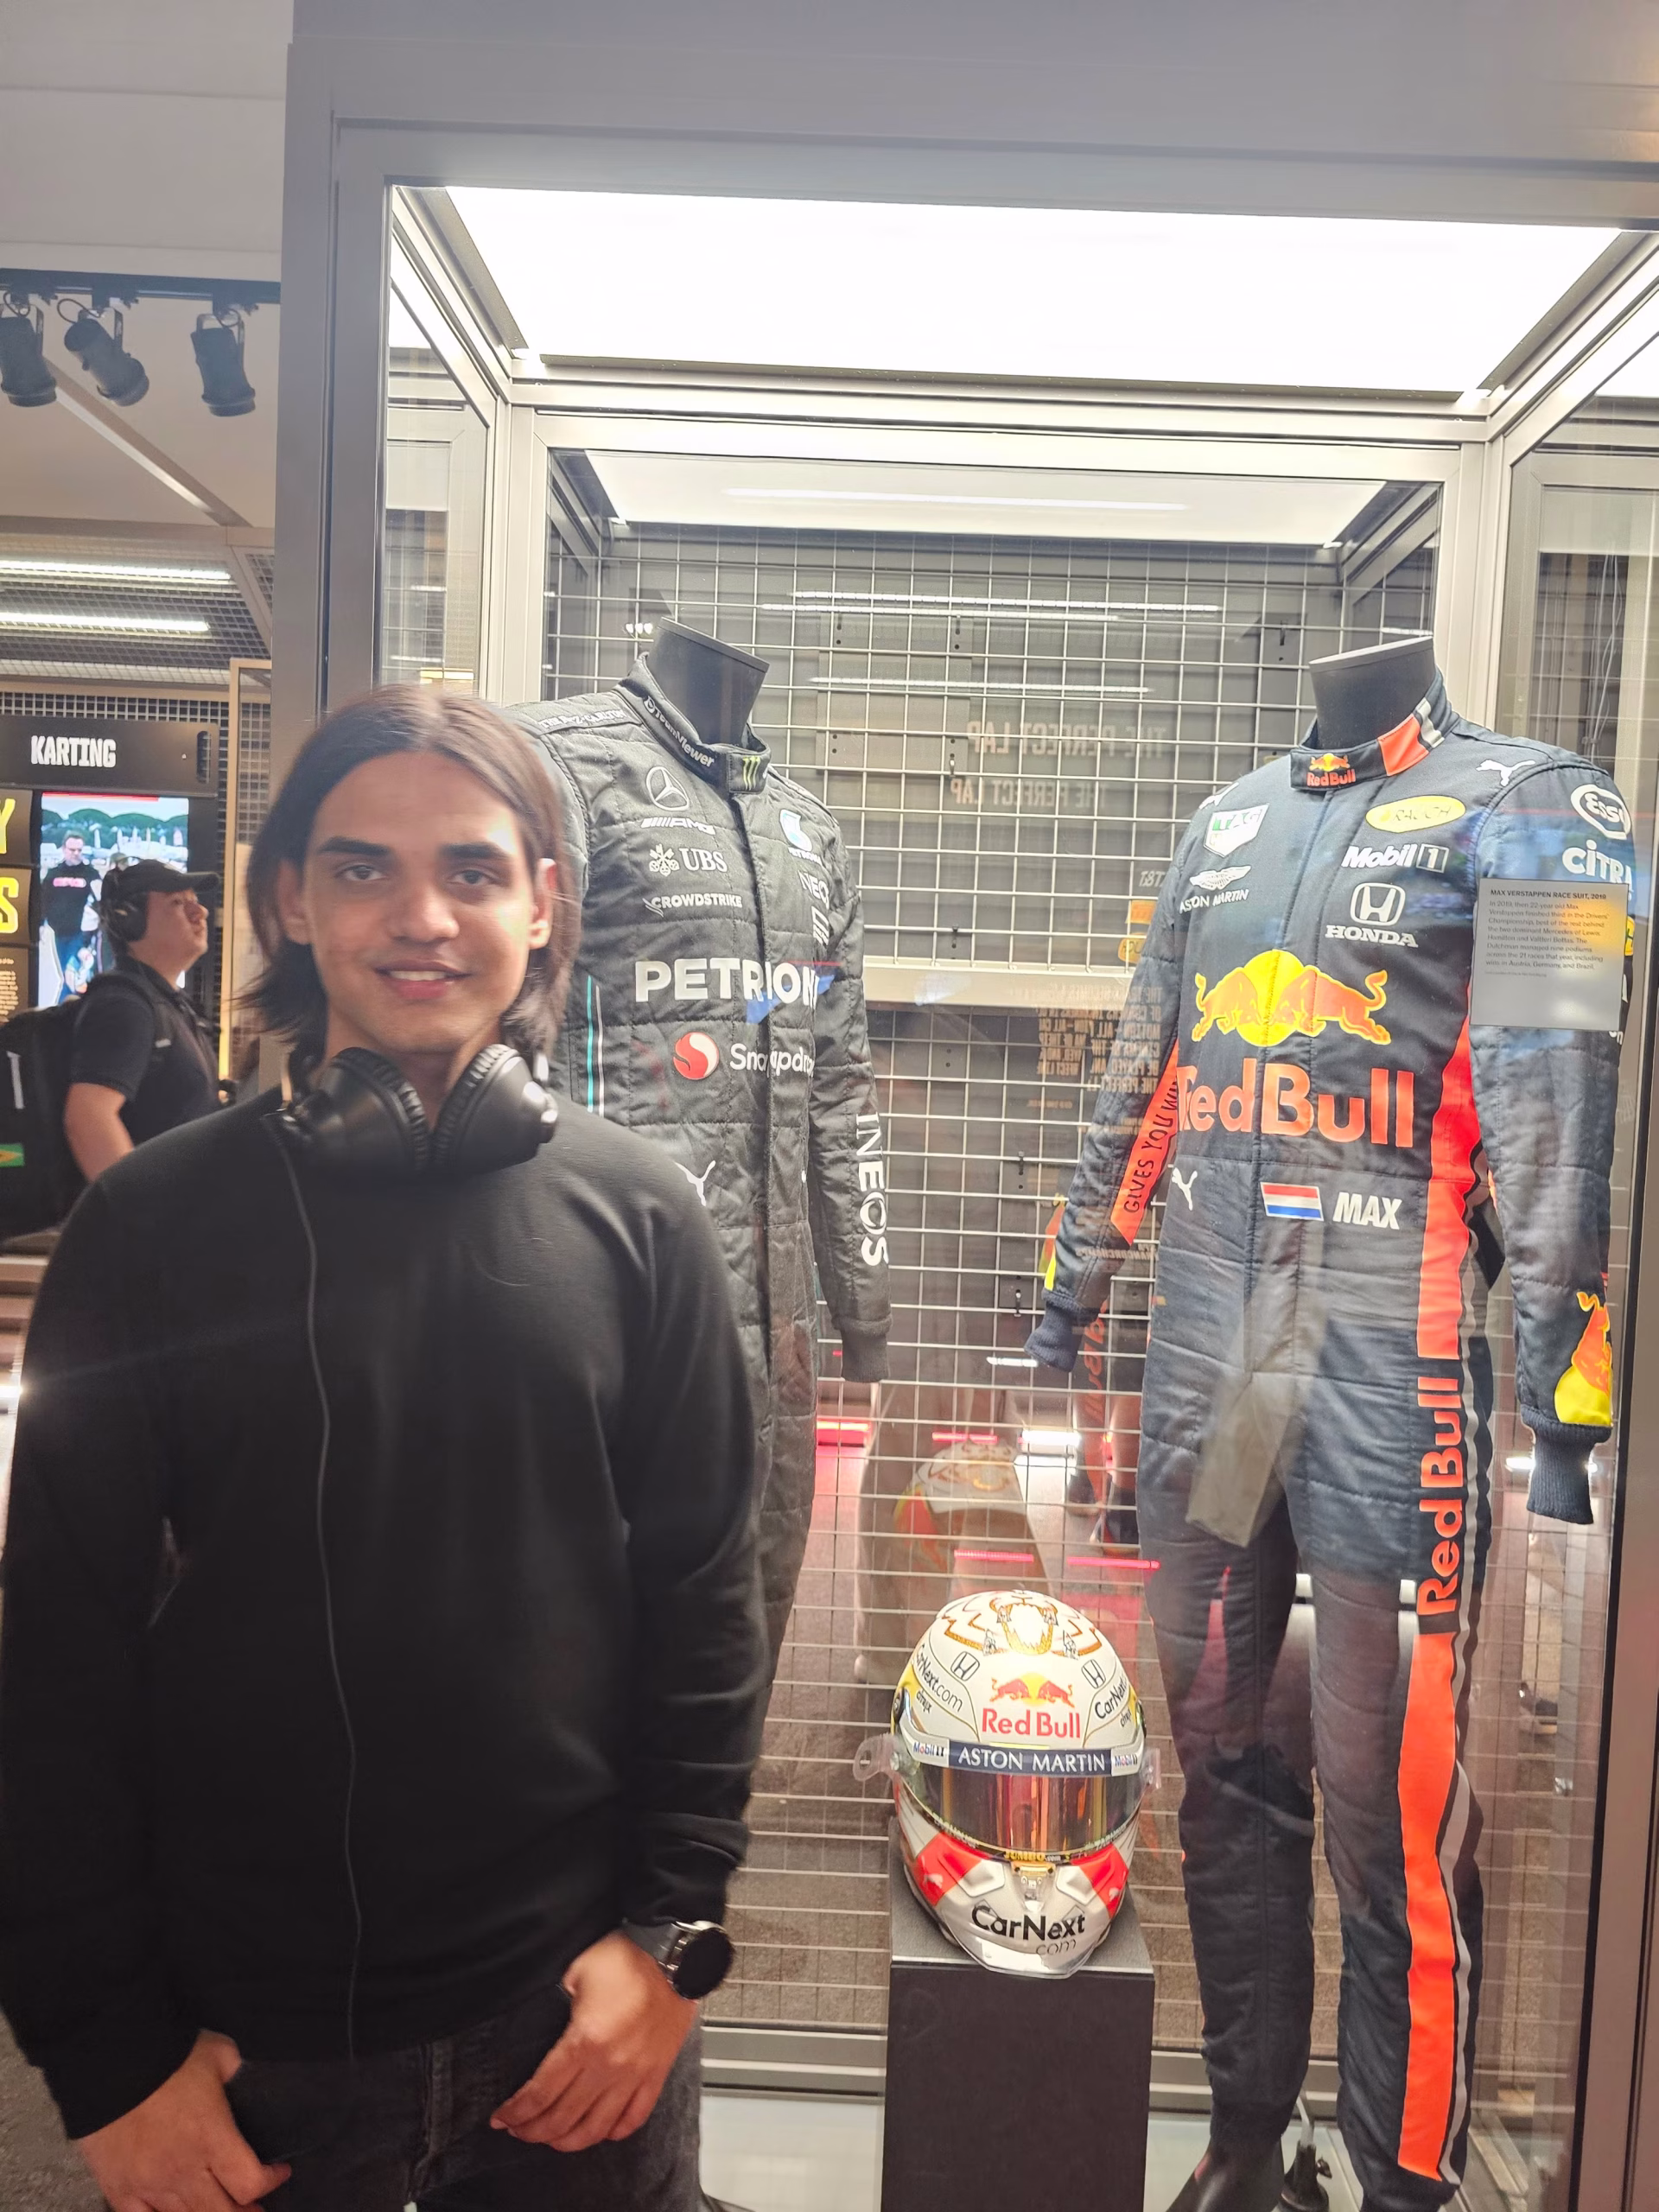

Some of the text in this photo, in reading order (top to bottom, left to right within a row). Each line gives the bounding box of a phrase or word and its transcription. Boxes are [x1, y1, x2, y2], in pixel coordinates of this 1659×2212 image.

[30, 734, 117, 768] KARTING
[654, 709, 716, 768] TeamViewer
[1306, 768, 1357, 787] Red Bull
[678, 848, 728, 873] UBS
[1341, 843, 1418, 868] Mobil
[650, 893, 743, 912] CROWDSTRIKE
[1325, 925, 1419, 949] HONDA
[1261, 1062, 1414, 1148] Bull
[1123, 1159, 1154, 1213] GIVES
[1141, 1113, 1173, 1151] YOU
[855, 1112, 889, 1267] INEOS
[1332, 1192, 1402, 1230] MAX
[1416, 1376, 1464, 1616] Red Bull
[982, 1707, 1081, 1738] Red Bull
[913, 1742, 935, 1757] Mobil
[958, 1746, 1105, 1772] ASTON MARTIN
[971, 1905, 1086, 1942] CarNext
